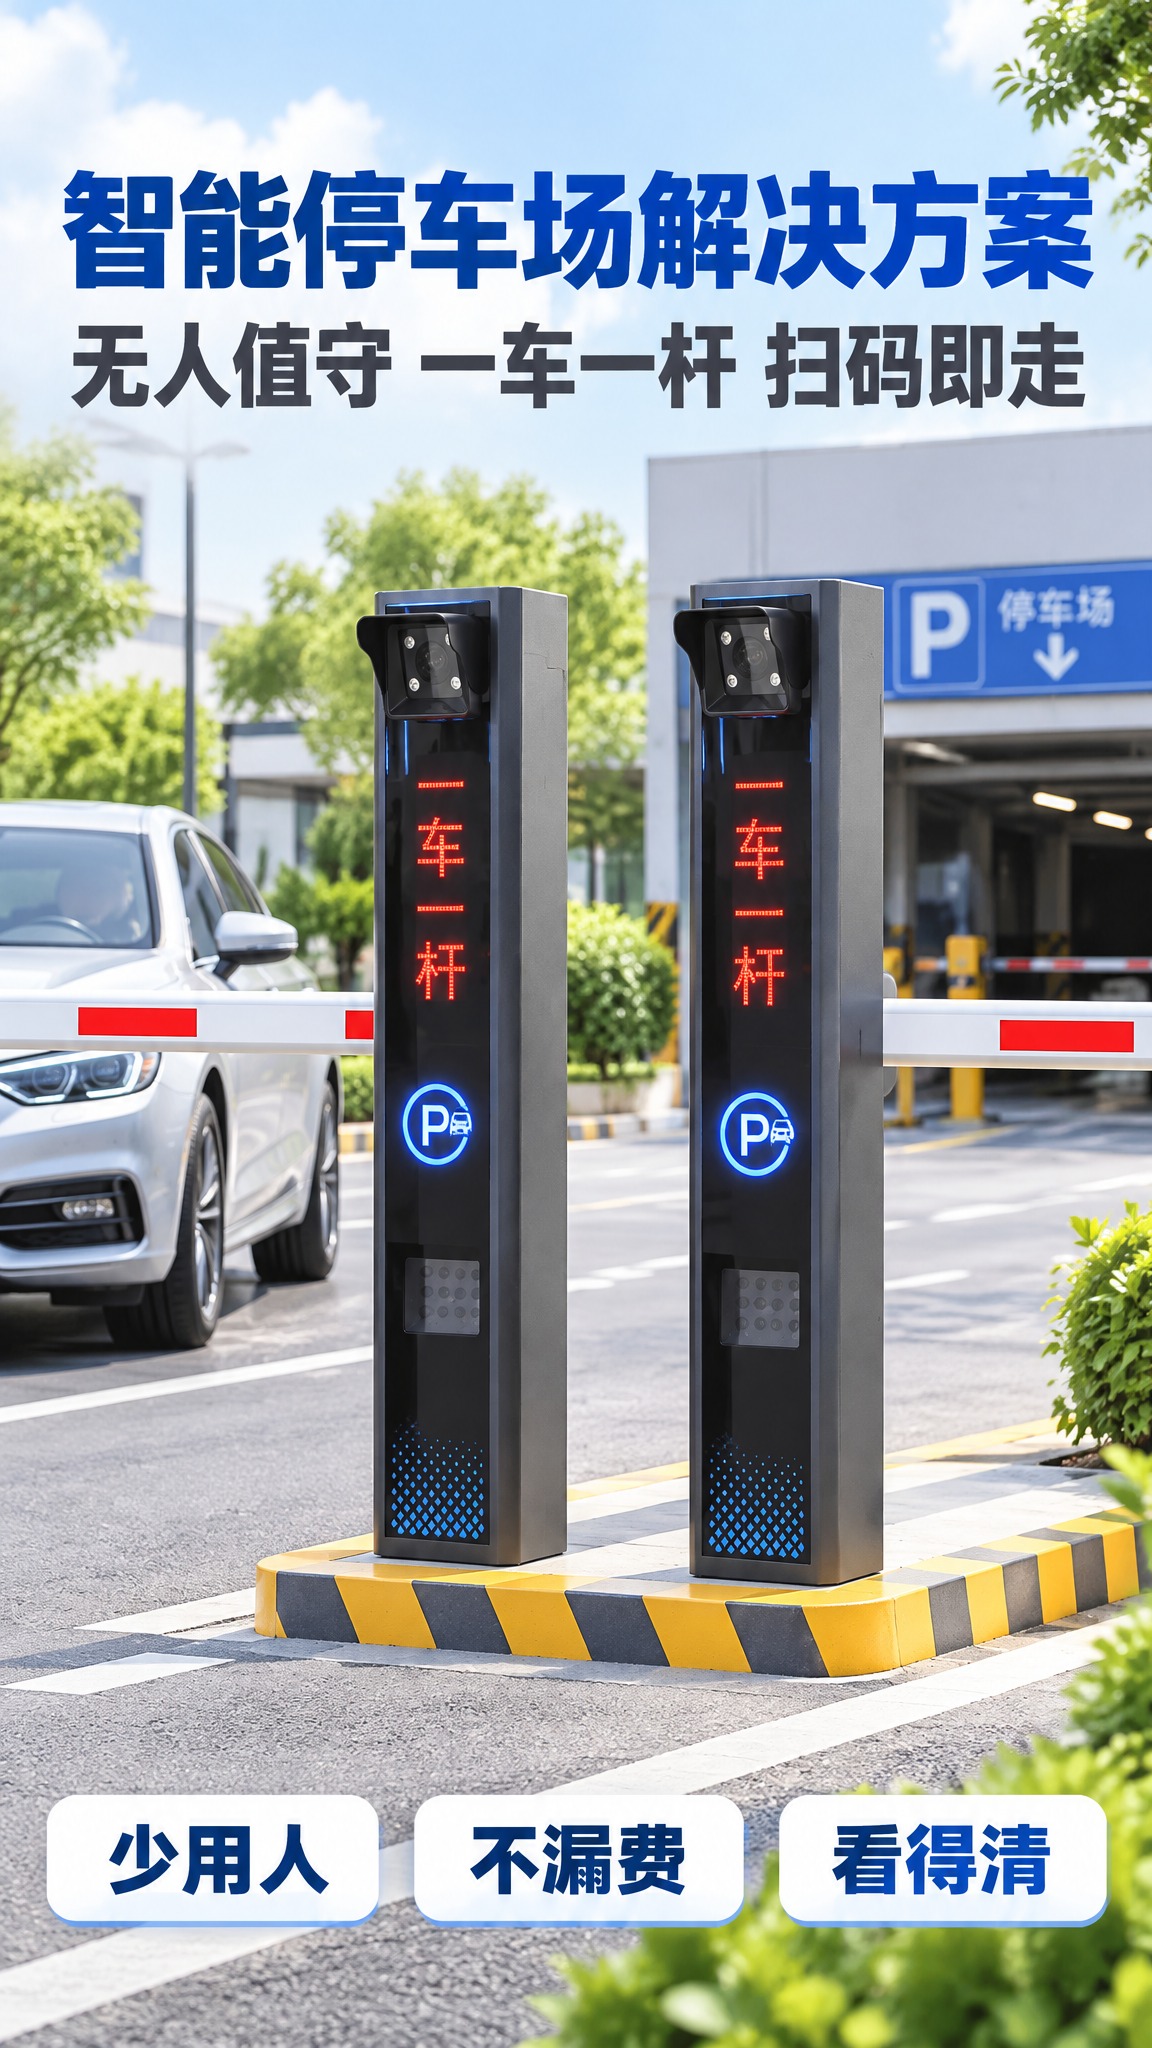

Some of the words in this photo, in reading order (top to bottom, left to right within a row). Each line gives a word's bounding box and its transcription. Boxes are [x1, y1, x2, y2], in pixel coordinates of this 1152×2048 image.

[910, 590, 971, 679] P
[998, 585, 1115, 632] 停车场
[415, 780, 467, 1001] 一车一杆
[733, 780, 785, 1007] 一车一杆
[421, 1104, 450, 1147] P
[740, 1113, 769, 1157] P
